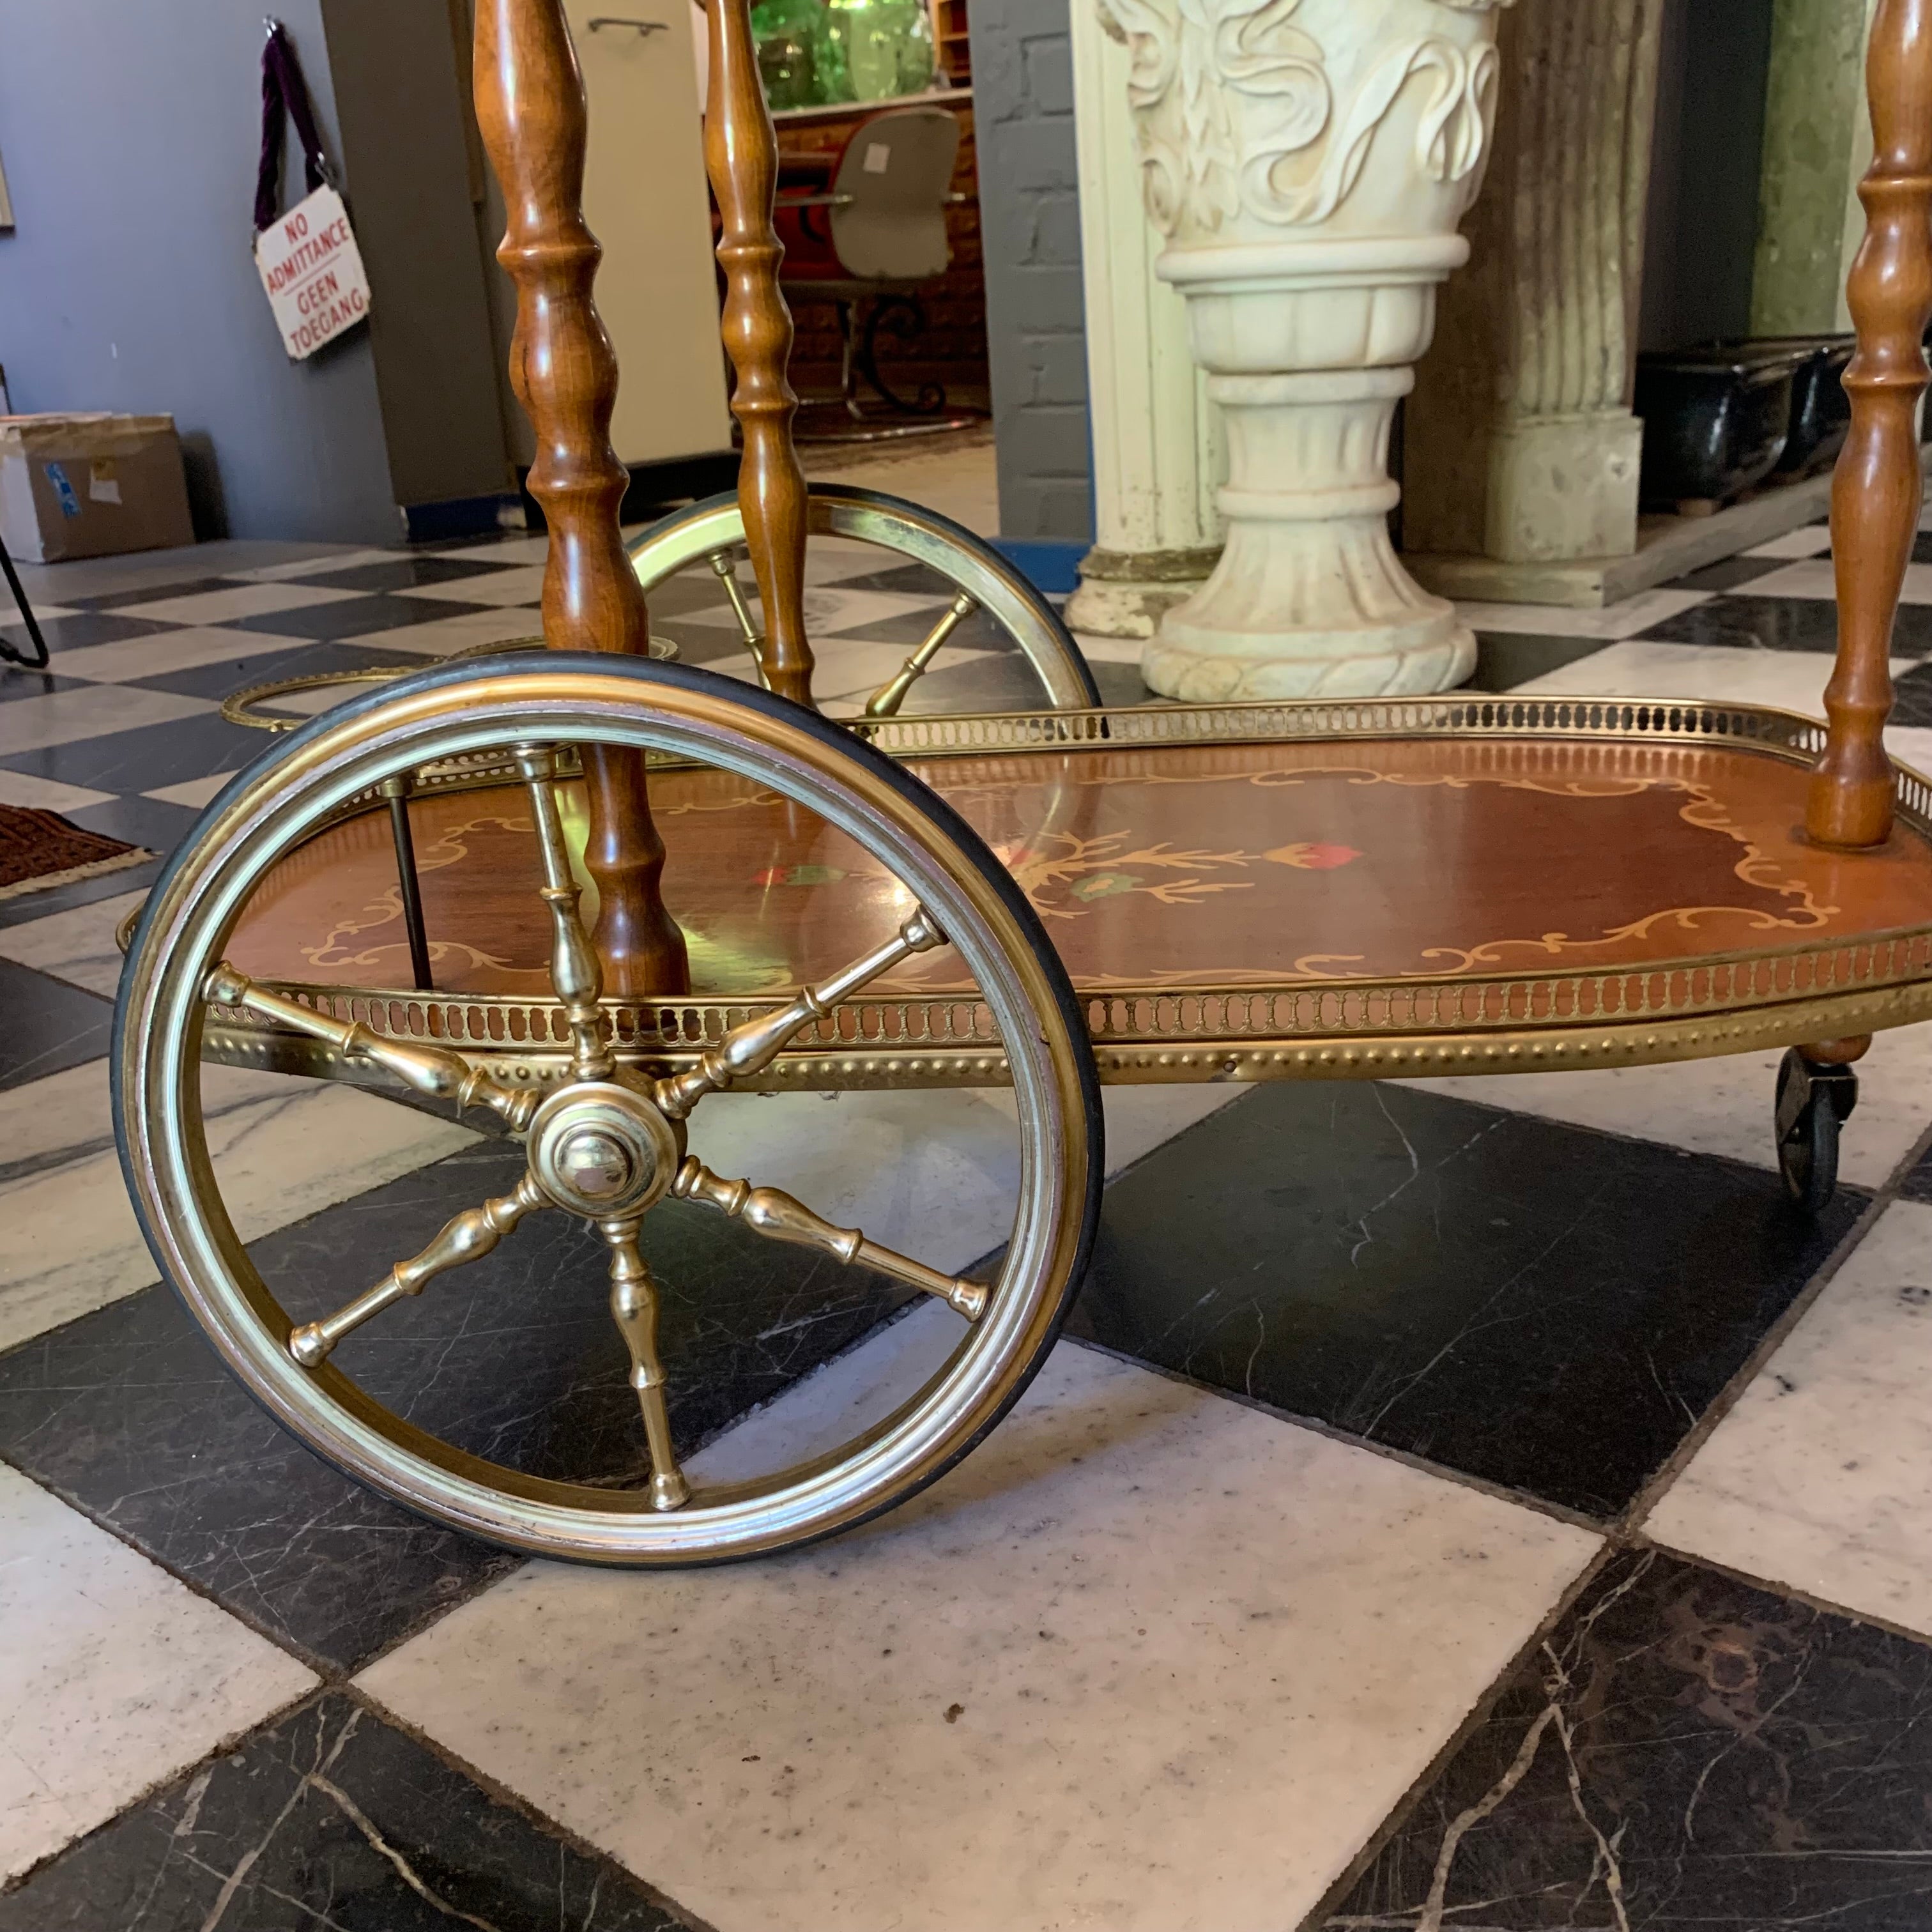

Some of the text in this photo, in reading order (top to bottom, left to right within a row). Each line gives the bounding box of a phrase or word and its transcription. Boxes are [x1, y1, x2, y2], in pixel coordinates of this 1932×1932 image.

[284, 213, 308, 244] NO
[266, 218, 349, 295] ADMITTANCE
[297, 271, 339, 314] GEEN
[290, 288, 364, 353] TOEGANG
